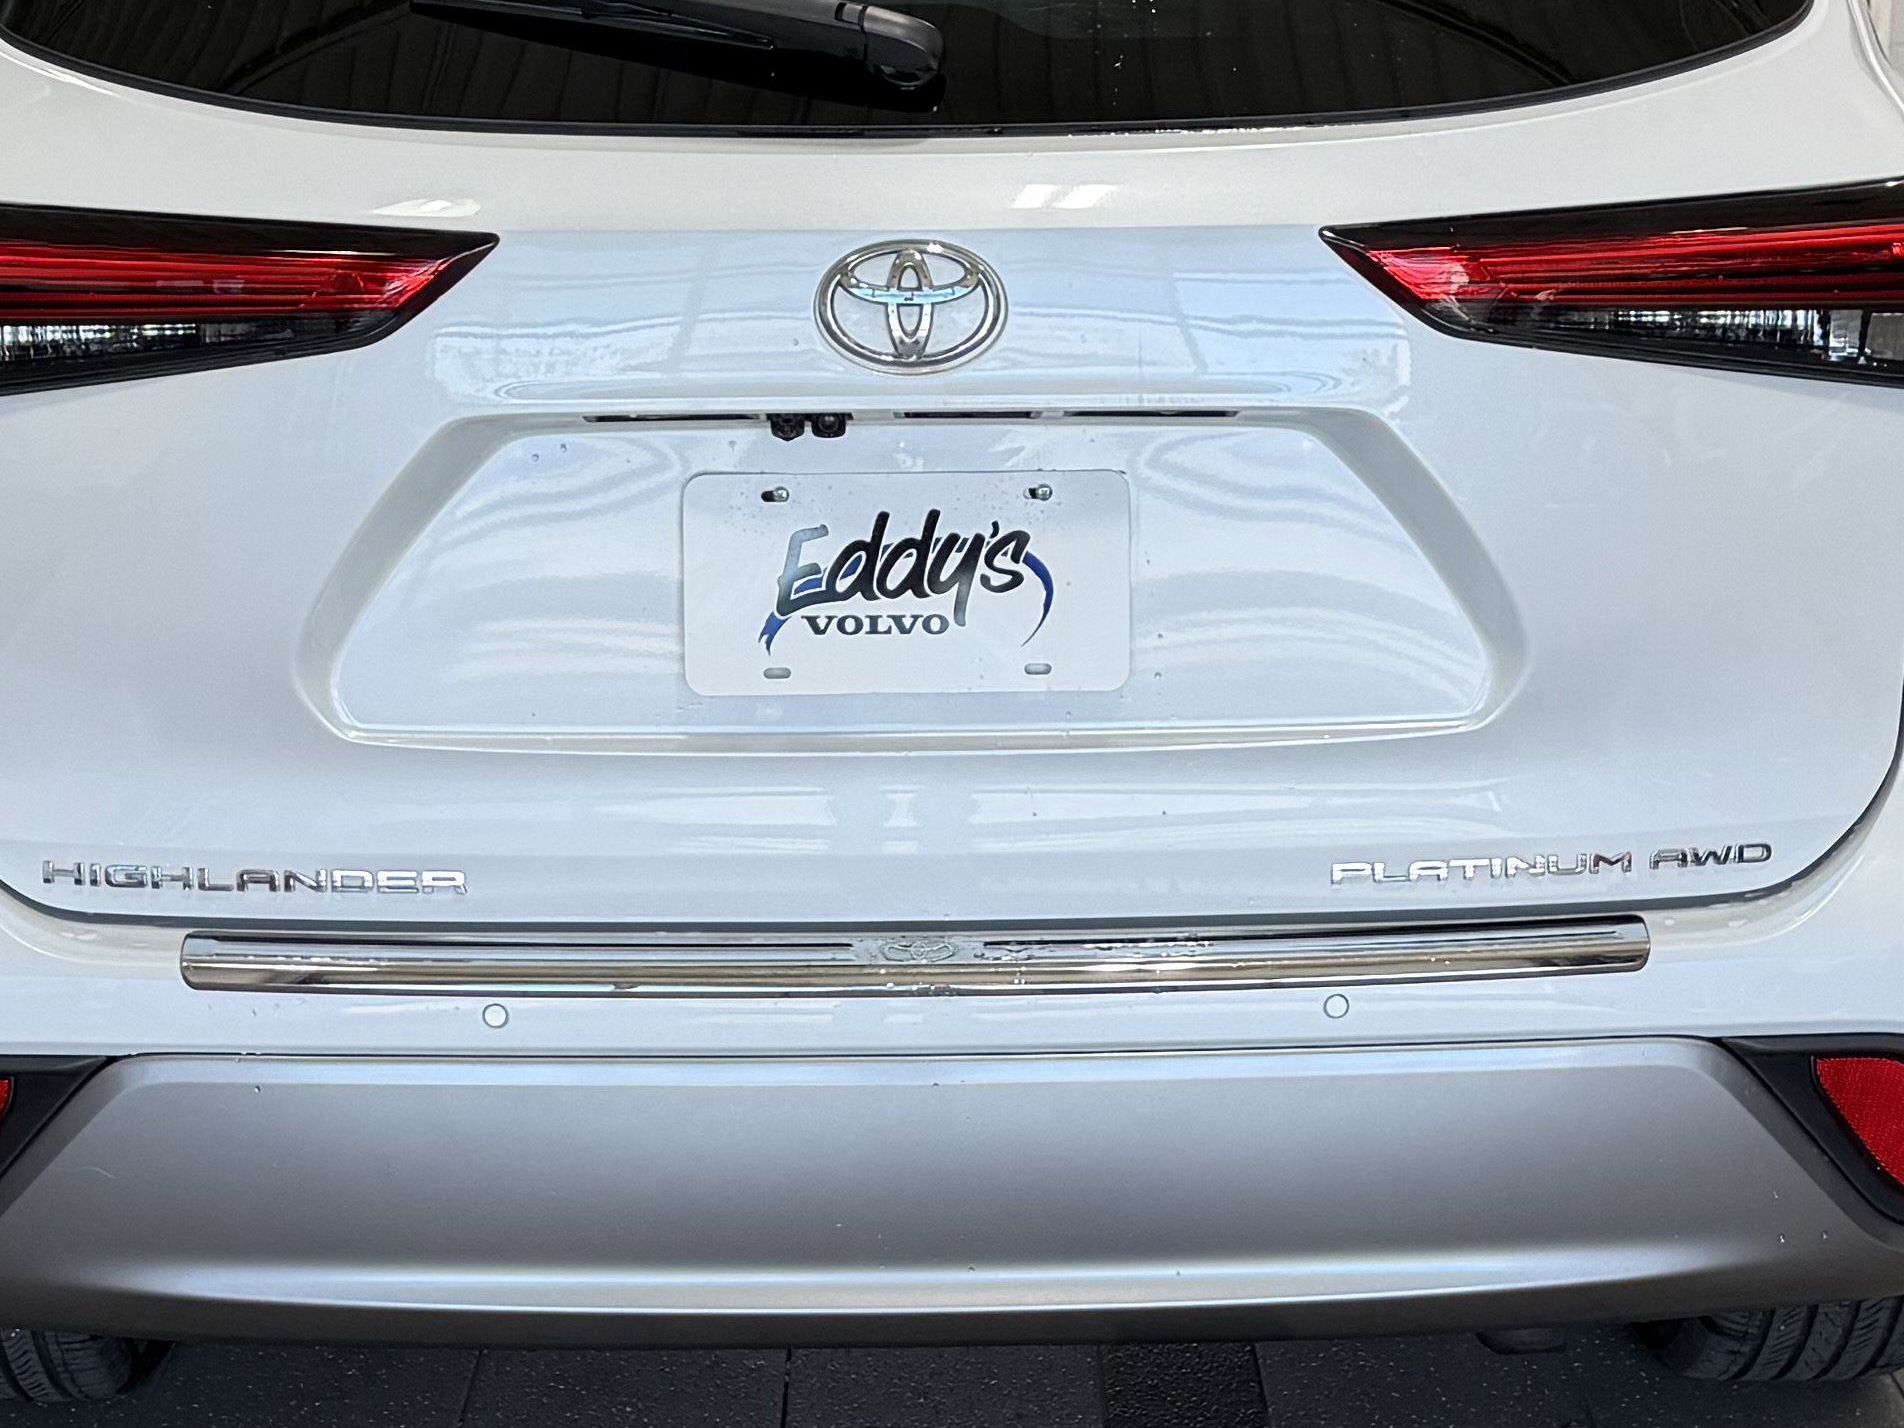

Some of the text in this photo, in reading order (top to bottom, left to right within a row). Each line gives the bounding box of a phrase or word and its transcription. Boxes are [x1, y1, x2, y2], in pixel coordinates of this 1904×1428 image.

[776, 509, 1030, 627] Eddy's
[801, 613, 949, 635] VOLVO
[42, 859, 469, 894] HIGHLANDER
[1330, 843, 1773, 884] PLATINUM AWD
